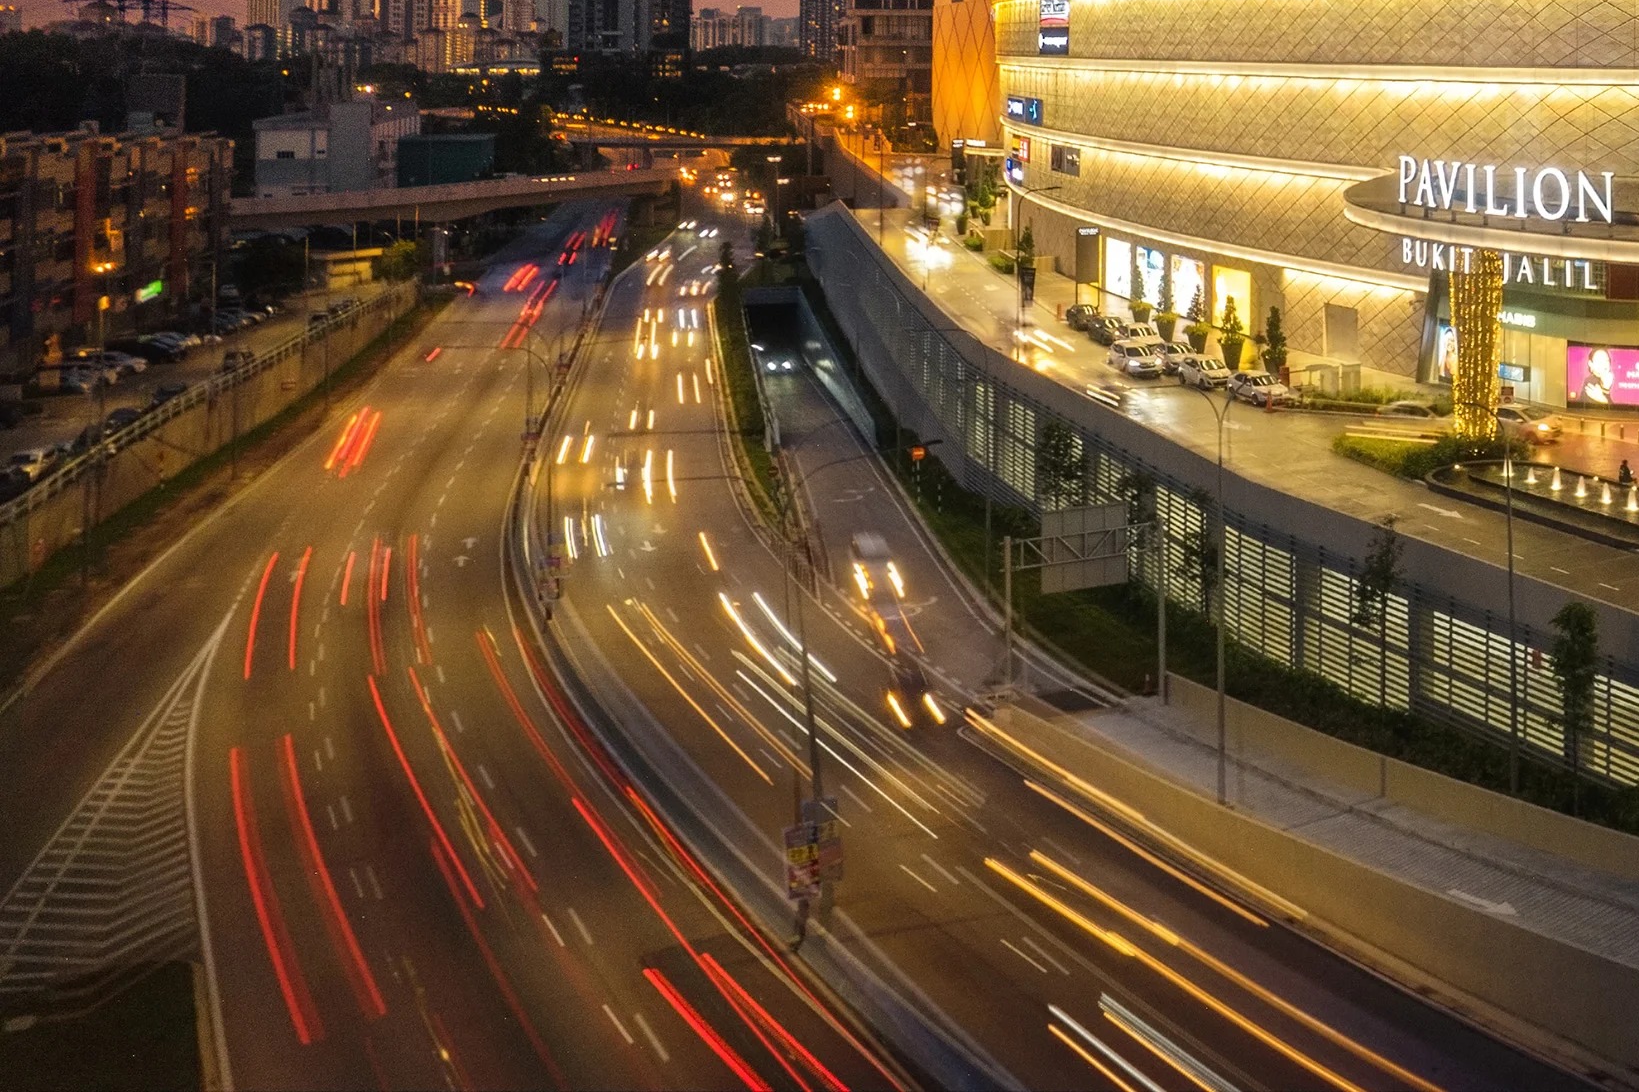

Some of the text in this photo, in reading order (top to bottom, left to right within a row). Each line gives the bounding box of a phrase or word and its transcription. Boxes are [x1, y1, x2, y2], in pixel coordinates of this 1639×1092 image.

[1398, 155, 1615, 224] PAVILION
[1402, 237, 1599, 290] BUKIT JALIL
